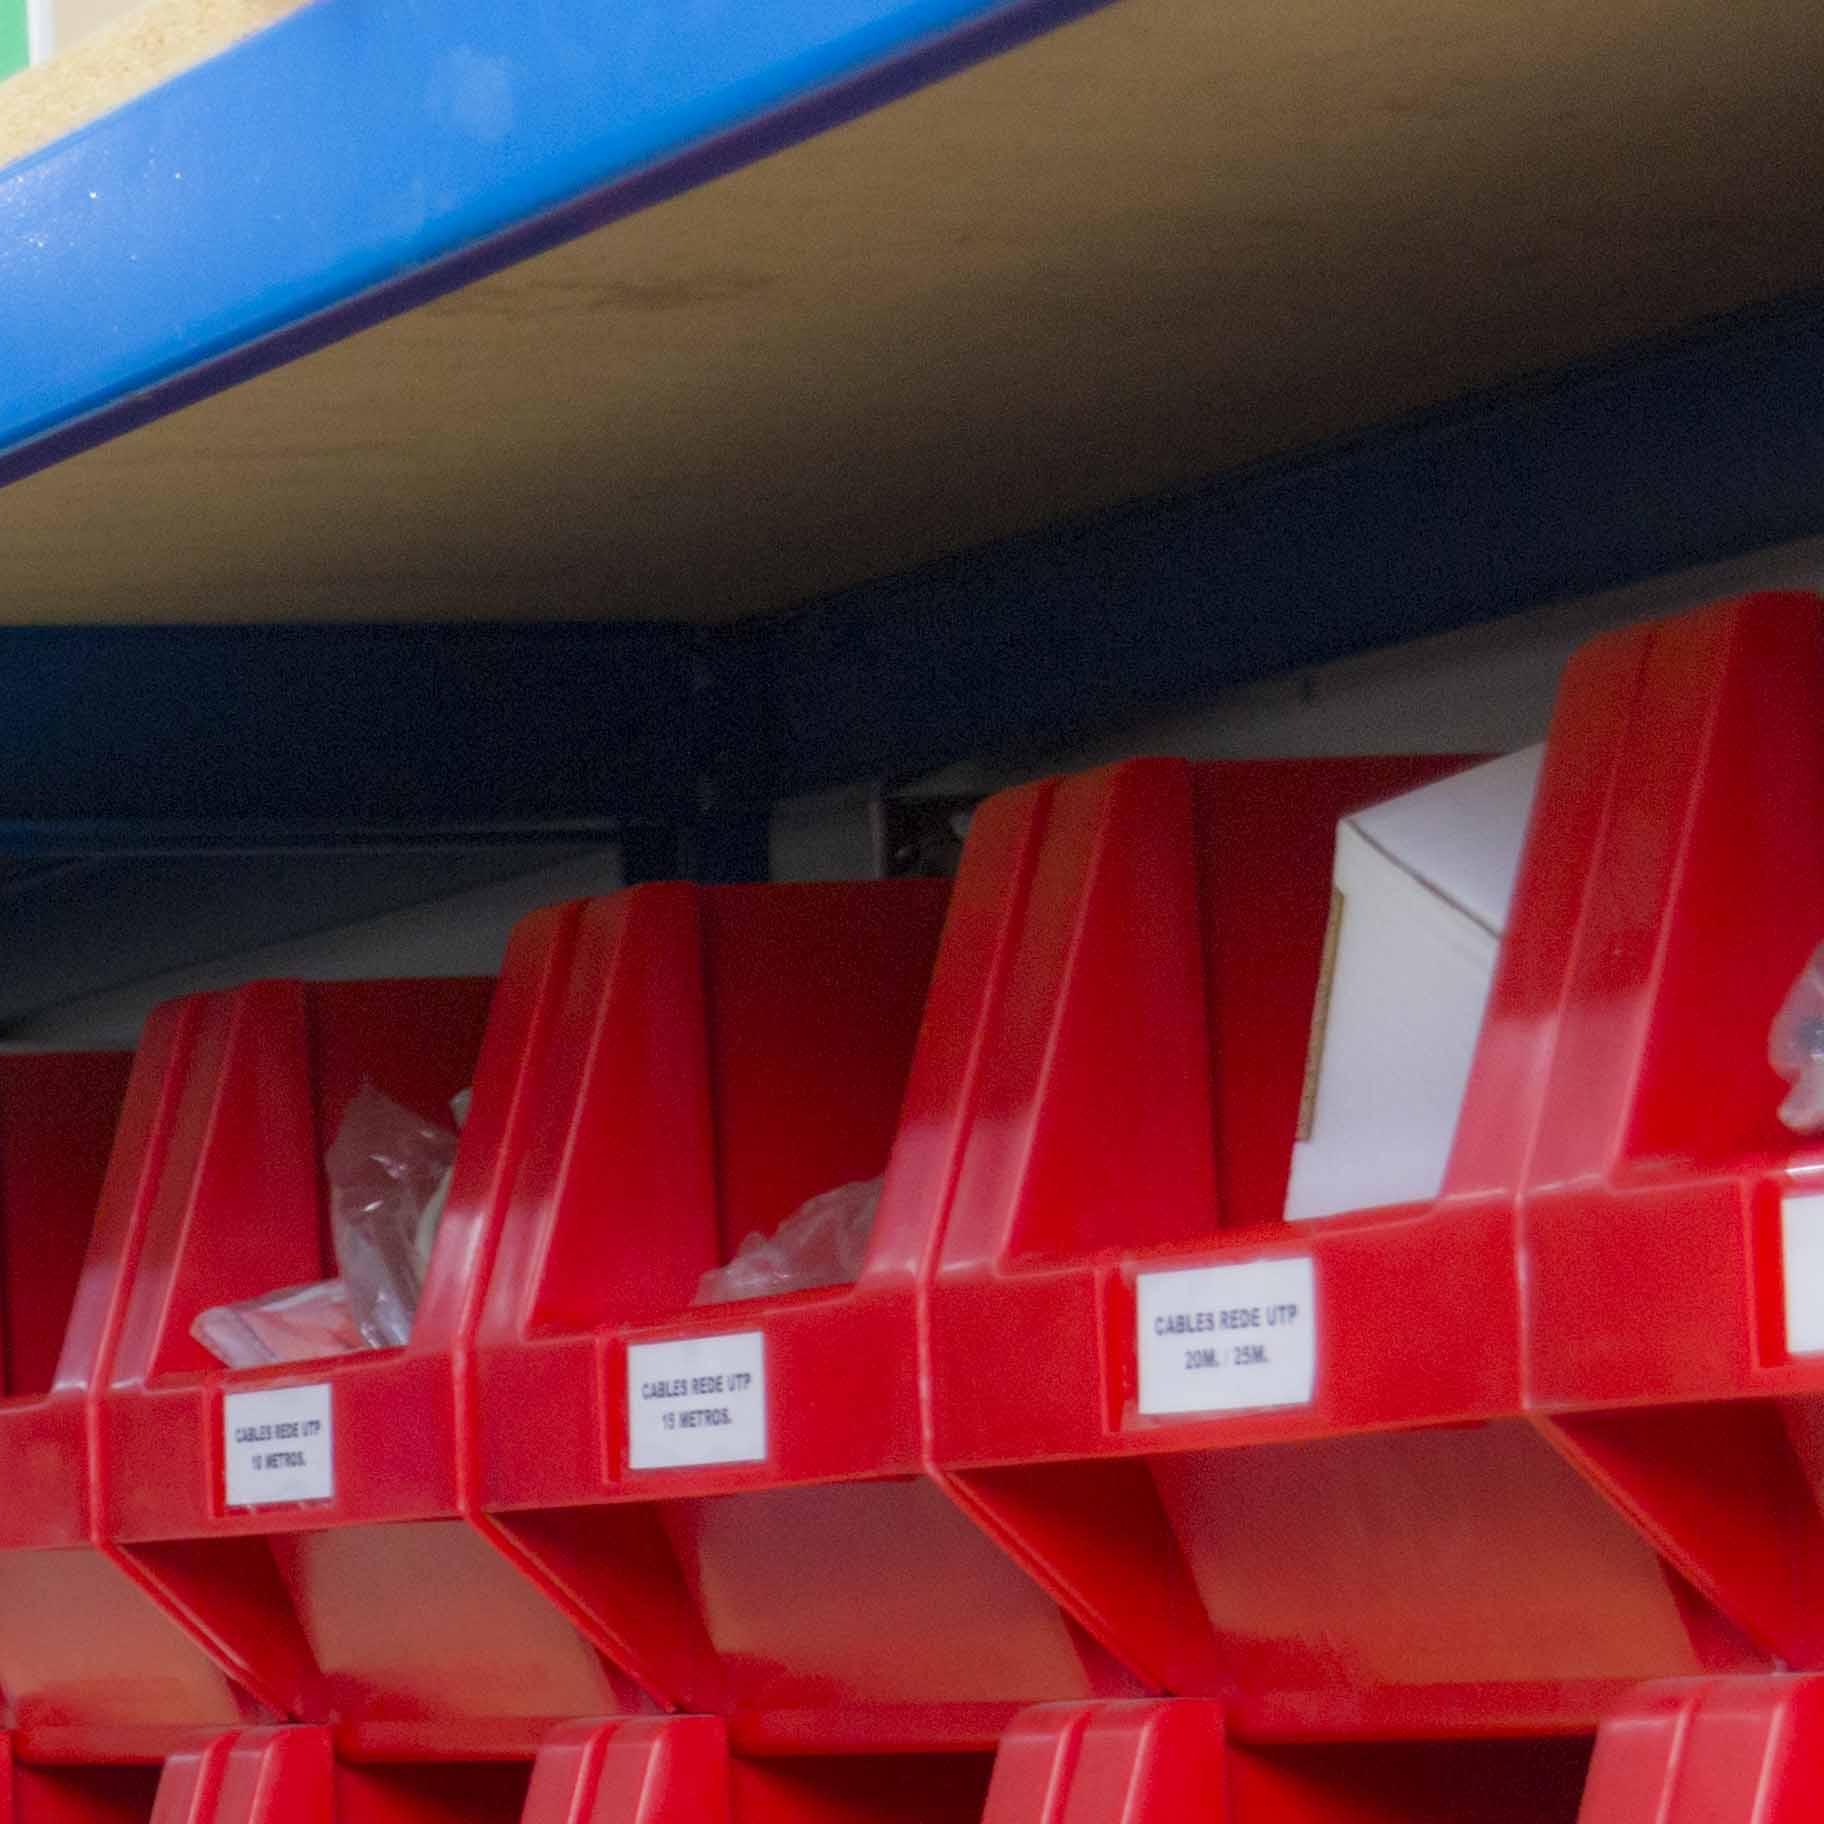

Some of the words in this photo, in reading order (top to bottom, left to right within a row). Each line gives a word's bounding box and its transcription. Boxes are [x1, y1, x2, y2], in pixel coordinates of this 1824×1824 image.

[1154, 1312, 1215, 1337] CABLES
[1219, 1306, 1261, 1330] REDE
[1266, 1304, 1299, 1327] UTP
[641, 1379, 688, 1400] CABLES
[692, 1375, 724, 1395] REDE
[728, 1372, 752, 1392] UTP
[236, 1426, 272, 1444] CABLES
[275, 1422, 300, 1440] REDE
